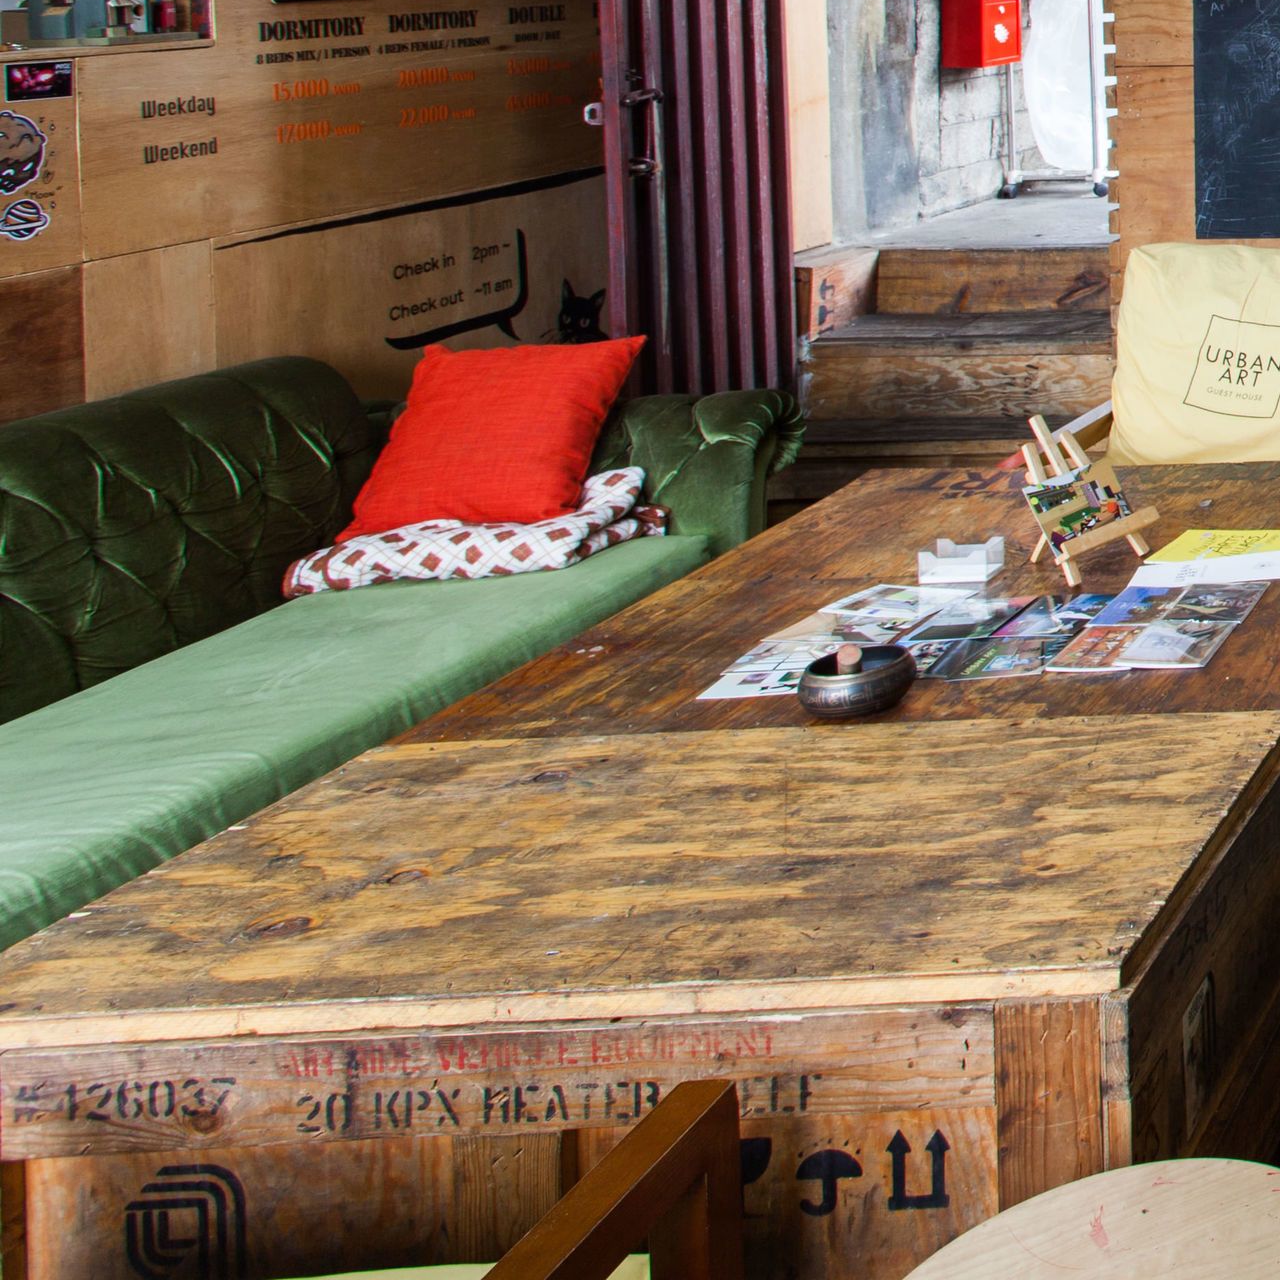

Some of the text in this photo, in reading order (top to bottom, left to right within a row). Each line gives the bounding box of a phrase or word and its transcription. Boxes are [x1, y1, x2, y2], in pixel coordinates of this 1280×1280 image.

[388, 10, 478, 33] DORMITORY
[508, 4, 566, 25] DOUBLE
[259, 17, 365, 42] DORMITORY
[457, 36, 490, 49] PERSON
[256, 54, 264, 65] 8
[266, 51, 294, 64] BEDS
[331, 45, 371, 59] PERSON
[273, 79, 361, 102] 15,000 won
[141, 95, 216, 119] Weekday
[144, 137, 218, 164] Weekend
[393, 258, 439, 280] Check
[442, 254, 456, 269] in
[472, 244, 499, 262] 2pm
[389, 298, 437, 321] Check
[440, 288, 465, 306] out
[1218, 367, 1263, 388] ART
[1206, 386, 1263, 402] GUEST HOUSE
[592, 1024, 783, 1064] EQUIPMENT
[374, 1088, 460, 1130] KPX
[482, 1080, 660, 1123] HEATER
